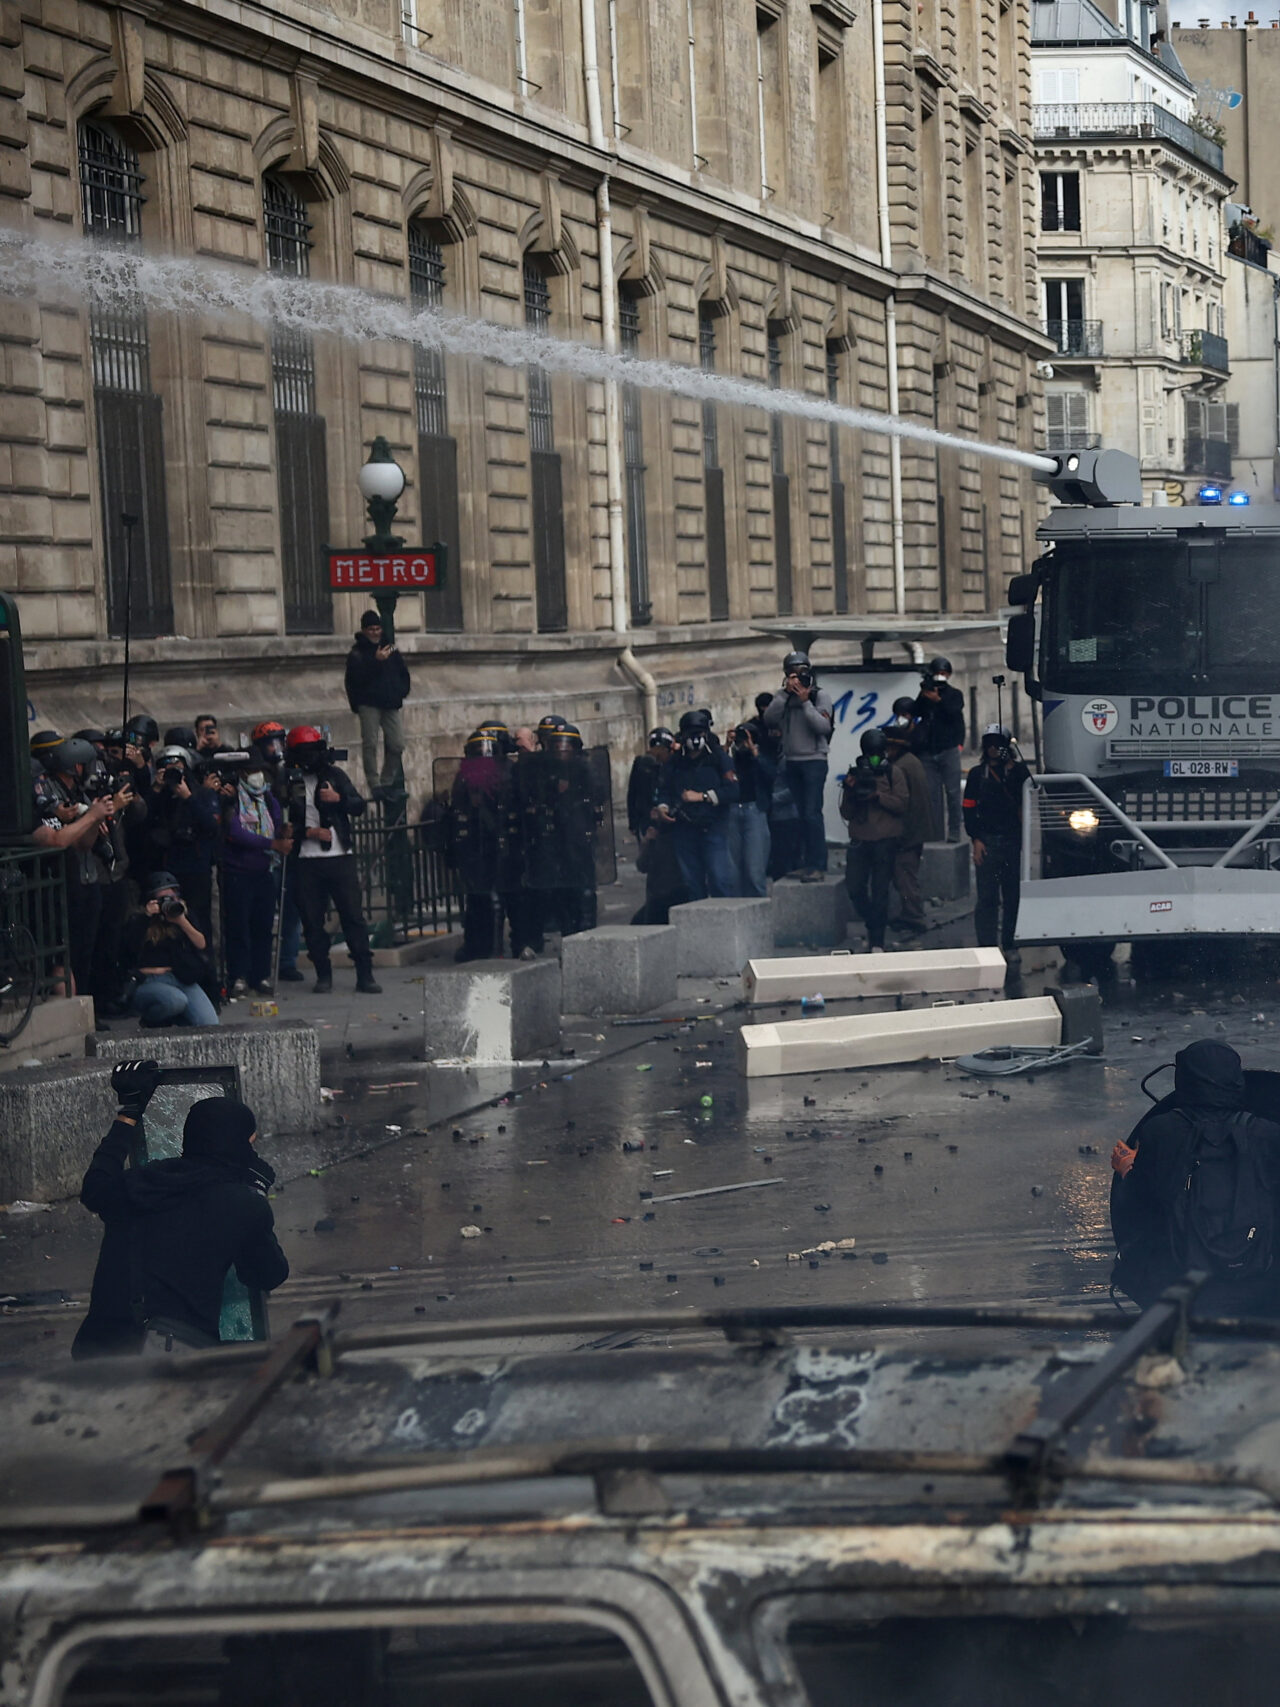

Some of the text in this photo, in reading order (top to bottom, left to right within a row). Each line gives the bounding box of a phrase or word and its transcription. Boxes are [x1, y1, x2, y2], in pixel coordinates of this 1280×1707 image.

[336, 559, 429, 582] METRO
[1130, 697, 1272, 720] POLICE
[1130, 722, 1273, 736] NATIONALE
[1151, 902, 1172, 911] ACAB
